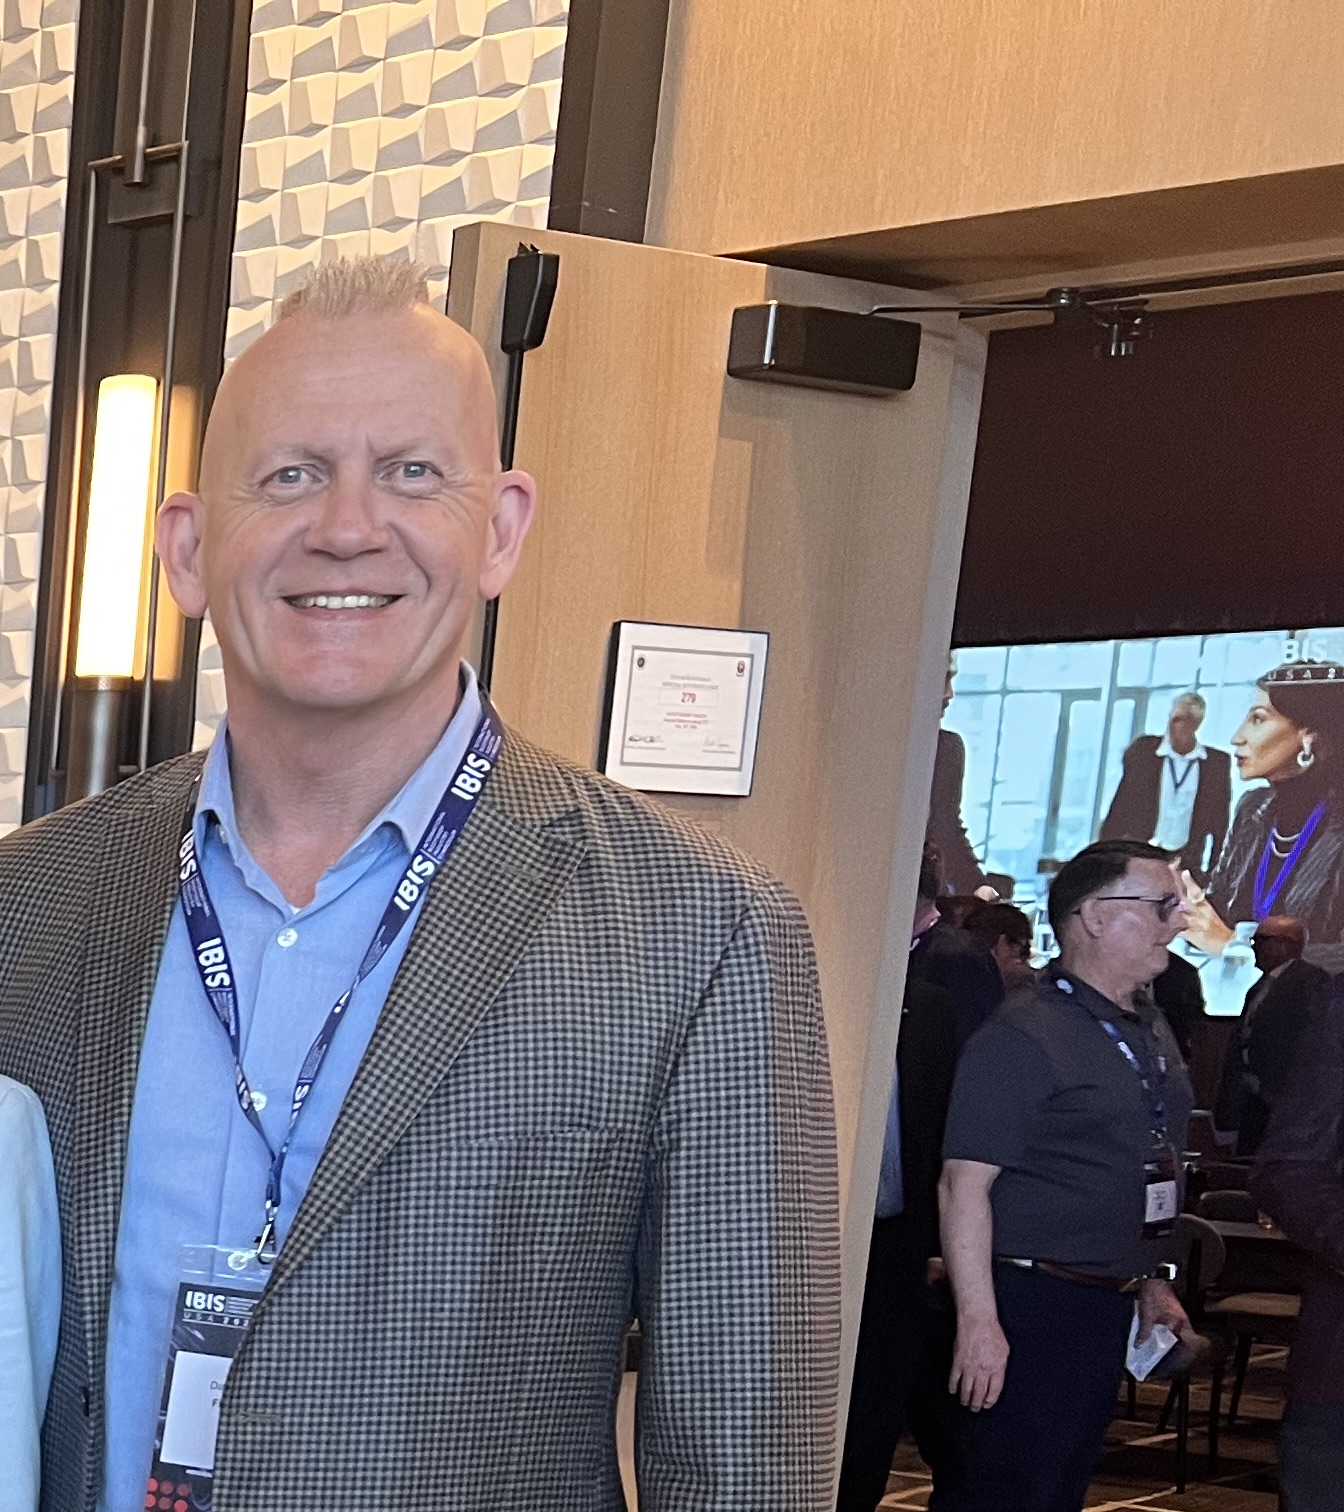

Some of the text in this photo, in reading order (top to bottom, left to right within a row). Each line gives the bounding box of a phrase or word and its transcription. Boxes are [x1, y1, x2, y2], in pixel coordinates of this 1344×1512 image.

[451, 752, 491, 801] IBIS
[394, 854, 435, 911] IBIS
[197, 937, 231, 989] IBIS
[183, 1311, 249, 1327] USA 202
[185, 1290, 226, 1312] IBIS
